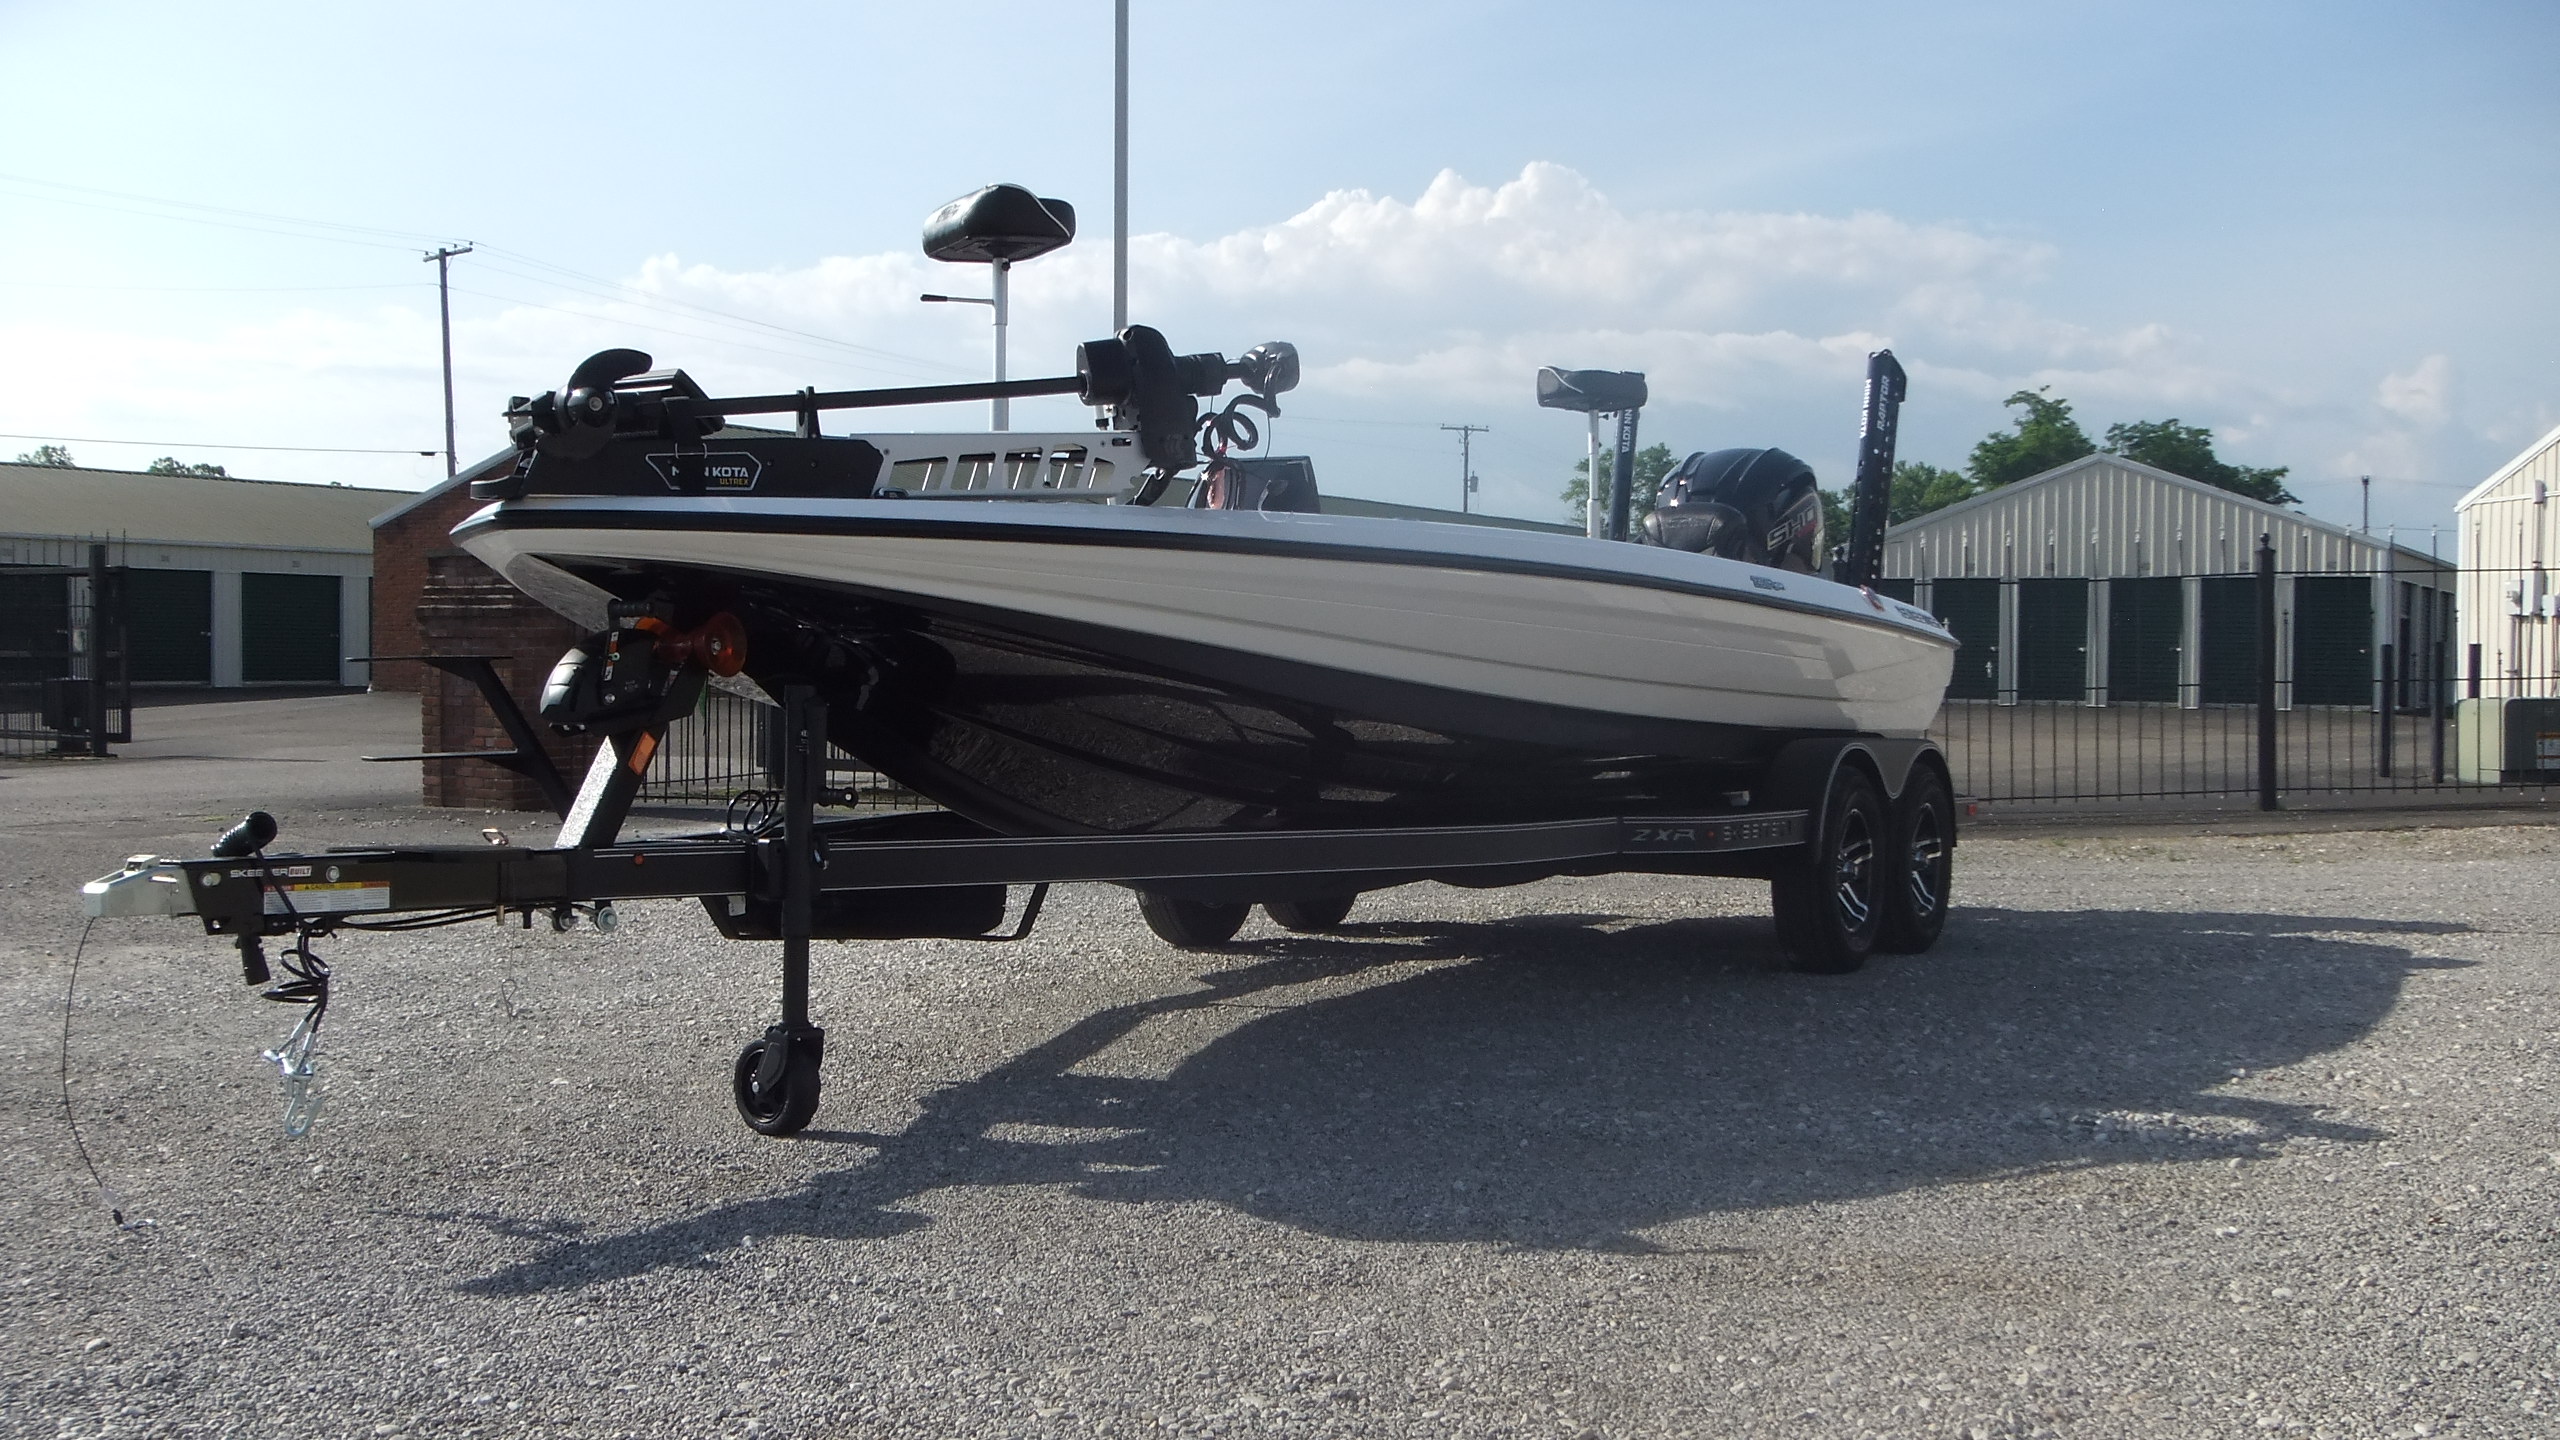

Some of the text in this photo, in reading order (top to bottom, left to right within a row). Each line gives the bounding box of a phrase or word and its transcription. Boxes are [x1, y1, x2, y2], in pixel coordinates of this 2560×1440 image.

[1877, 375, 1889, 431] RAPTOR
[1621, 425, 1631, 453] KOTA
[712, 466, 749, 477] KOTA
[1631, 829, 1696, 841] ZXR
[230, 866, 312, 878] SKEEER BUILT
